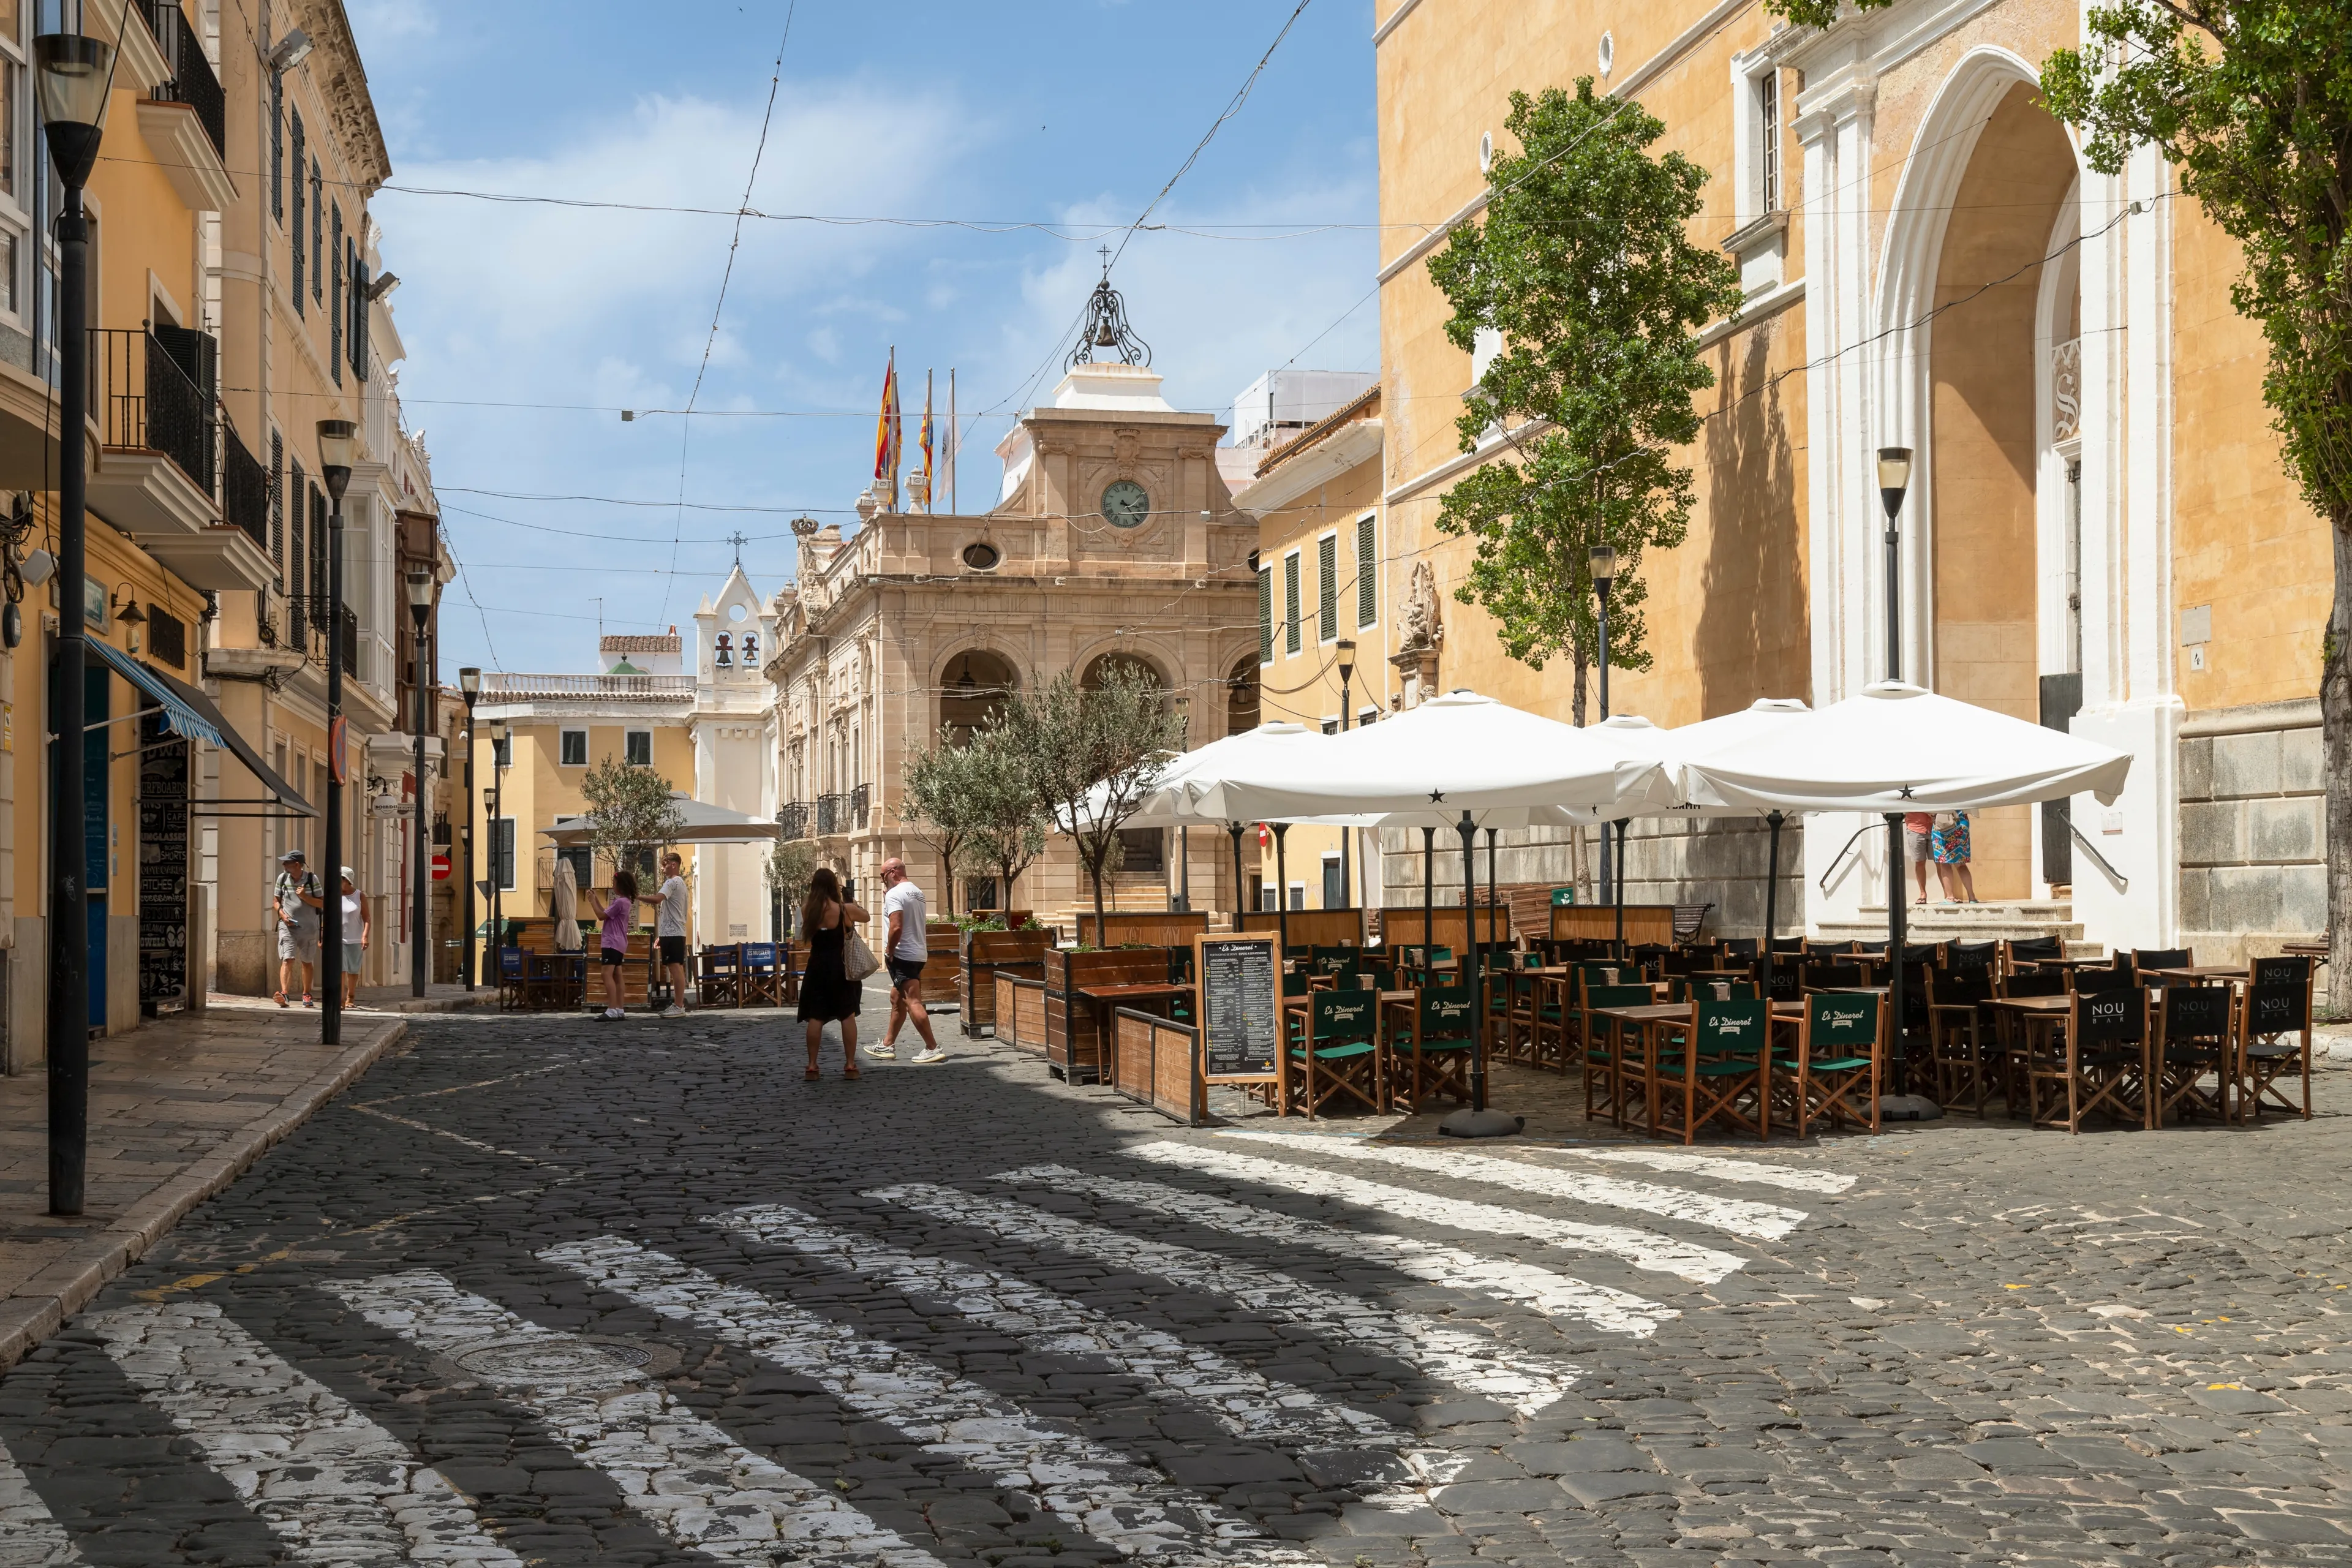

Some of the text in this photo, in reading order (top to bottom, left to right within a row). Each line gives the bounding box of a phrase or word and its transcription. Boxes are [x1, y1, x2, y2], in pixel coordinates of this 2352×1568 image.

[2194, 652, 2201, 665] 4
[141, 782, 186, 794] URFBOARDS
[167, 813, 186, 821] CAPS
[141, 832, 186, 841] UNGLASSES
[161, 850, 186, 861] SHORTS
[141, 865, 186, 875] ODYBOARDS
[140, 878, 173, 890] ATCHES
[140, 893, 186, 903] CCESSORIES
[140, 937, 165, 948] OWELS
[1959, 952, 1982, 961] NOU
[1645, 960, 1660, 968] NO
[2264, 968, 2291, 978] NOU
[1324, 1003, 1364, 1015] Es Dineret
[1431, 1000, 1471, 1010] Es Dineret
[2179, 1001, 2209, 1012] NOU
[2261, 997, 2289, 1010] NOU
[1822, 1009, 1864, 1021] Es Dineret
[2092, 1003, 2124, 1016] NOU
[2261, 1011, 2290, 1019] BAR
[1709, 1016, 1752, 1027] Es Dineret
